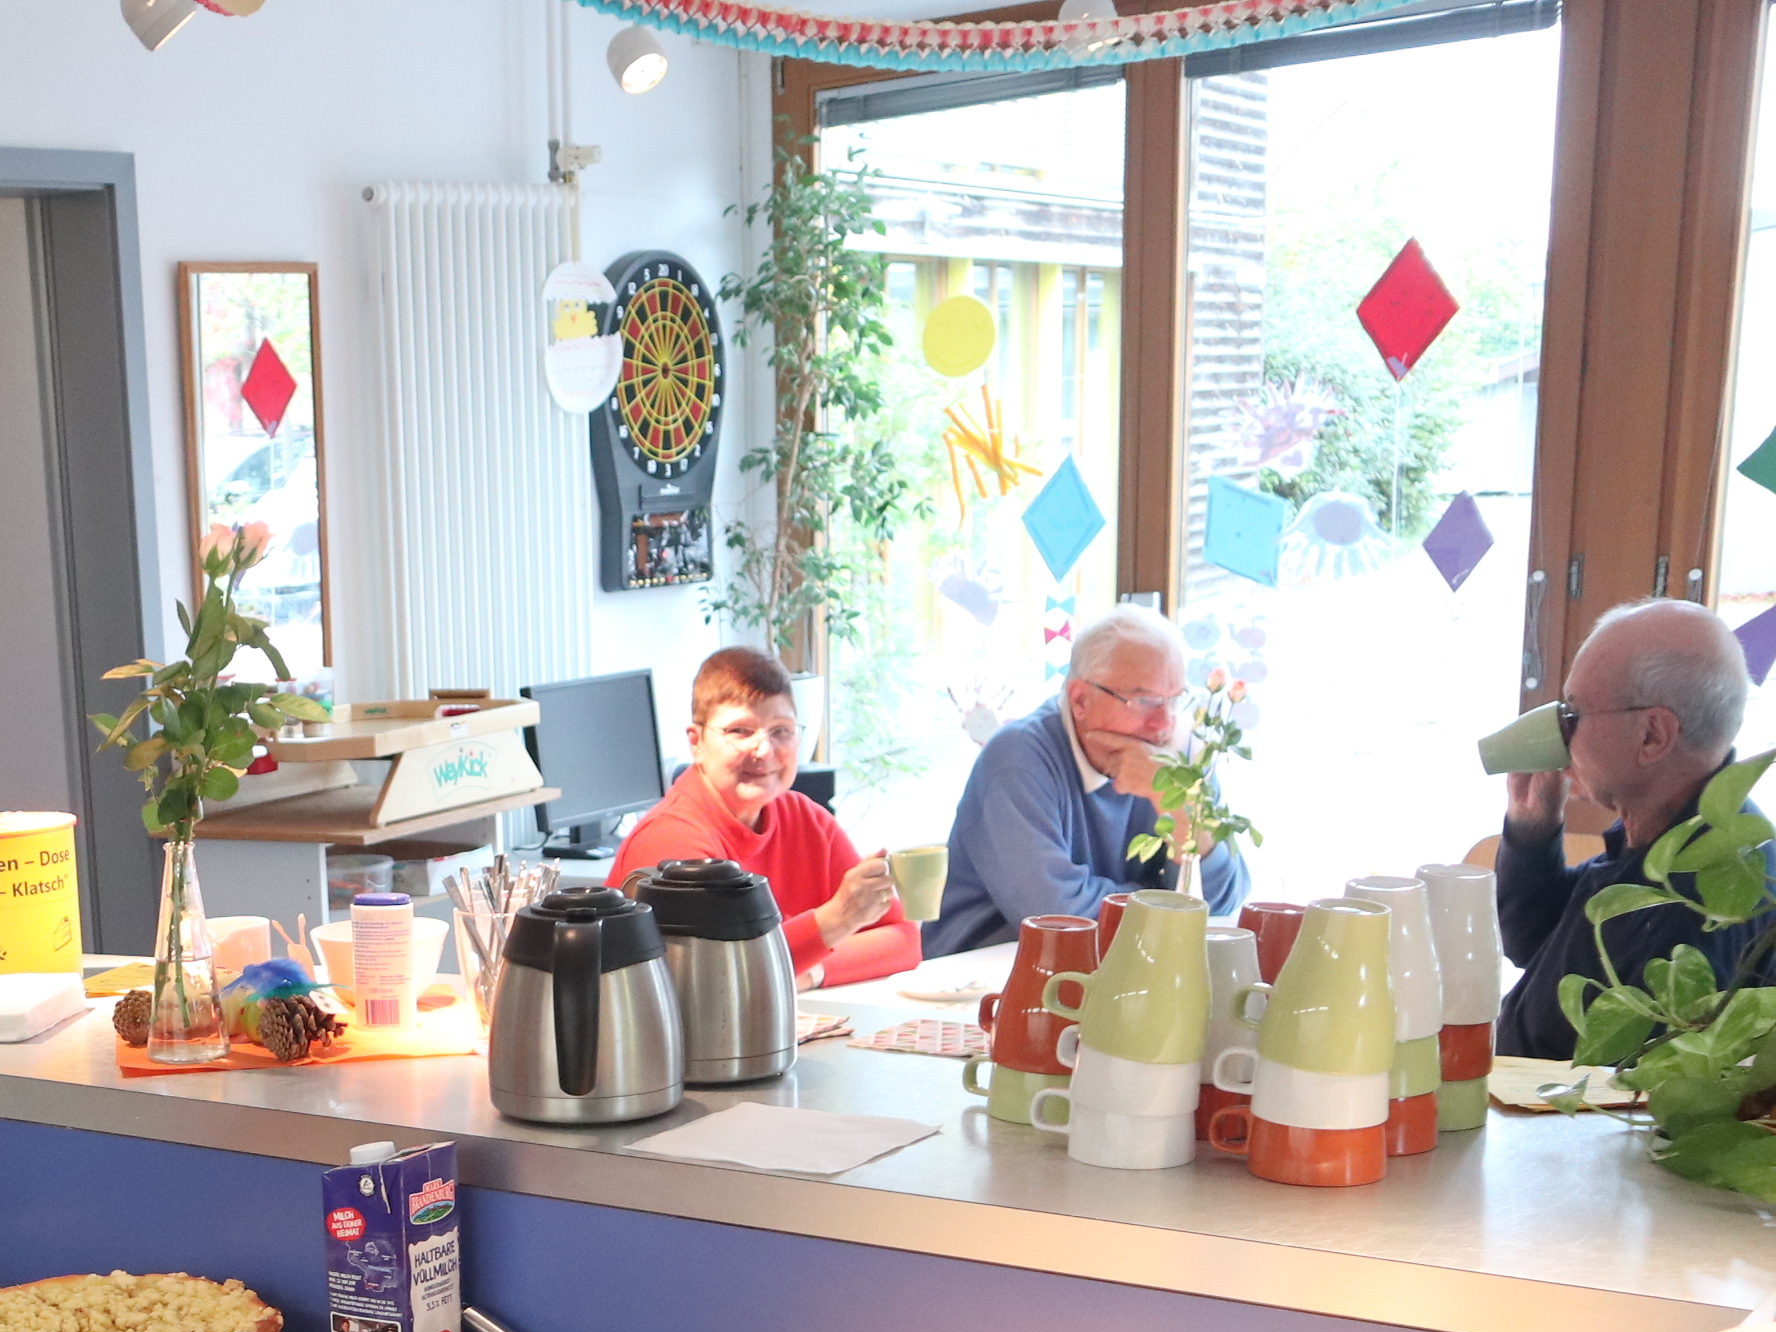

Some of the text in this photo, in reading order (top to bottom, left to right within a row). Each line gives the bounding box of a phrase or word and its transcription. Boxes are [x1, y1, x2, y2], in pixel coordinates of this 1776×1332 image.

[40, 849, 70, 867] Dose
[333, 1211, 354, 1222] MILCH
[414, 1240, 456, 1268] HALTBARE
[413, 1257, 458, 1287] VOLLMILCH
